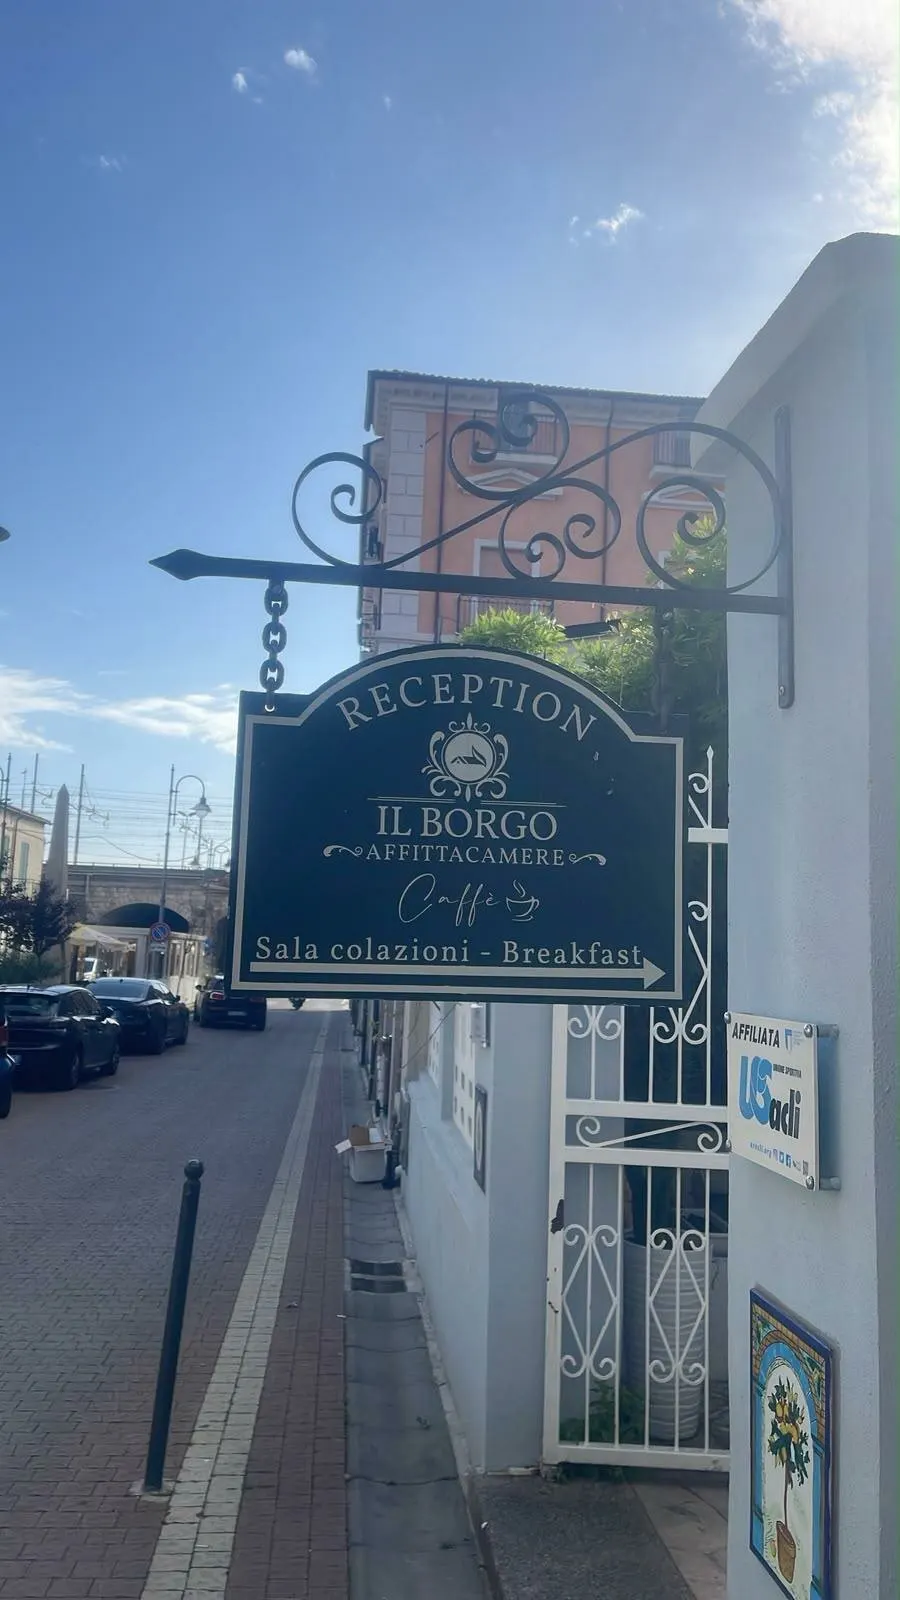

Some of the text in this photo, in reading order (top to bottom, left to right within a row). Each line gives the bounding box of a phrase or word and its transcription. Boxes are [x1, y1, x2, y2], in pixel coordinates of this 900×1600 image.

[336, 673, 597, 742] RECEPTION
[377, 806, 558, 841] IL BORGO
[366, 844, 565, 866] AFFITTACAMERE
[398, 873, 496, 928] Caffè
[255, 936, 319, 961] Sala
[330, 938, 470, 963] colazioni
[502, 941, 642, 966] Breakfast
[732, 1022, 780, 1048] AFFILIATA
